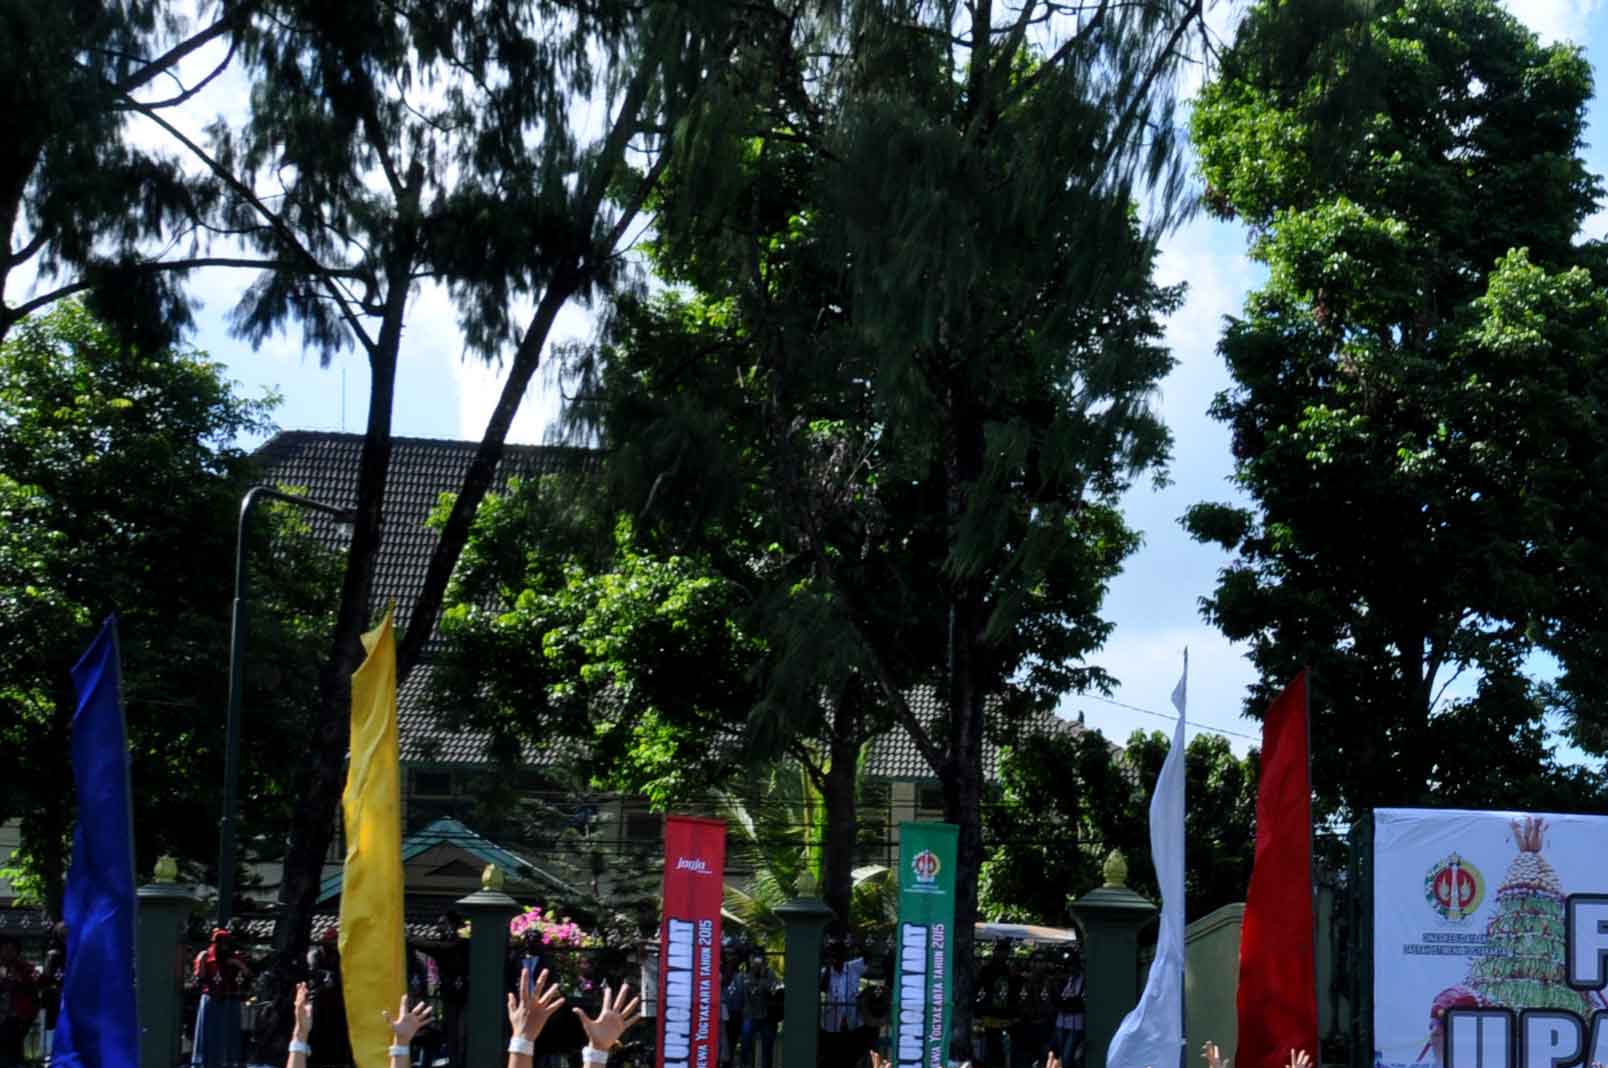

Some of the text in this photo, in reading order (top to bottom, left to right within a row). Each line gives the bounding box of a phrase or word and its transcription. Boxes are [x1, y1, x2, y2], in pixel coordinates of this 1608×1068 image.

[667, 918, 695, 969] ADAT
[699, 919, 713, 946] 2015
[901, 923, 928, 972] ADAT
[931, 923, 945, 949] 2015
[664, 970, 693, 1059] UPACARA
[696, 979, 712, 1041] YOGYAKARTA
[898, 974, 926, 1060] UPACARA
